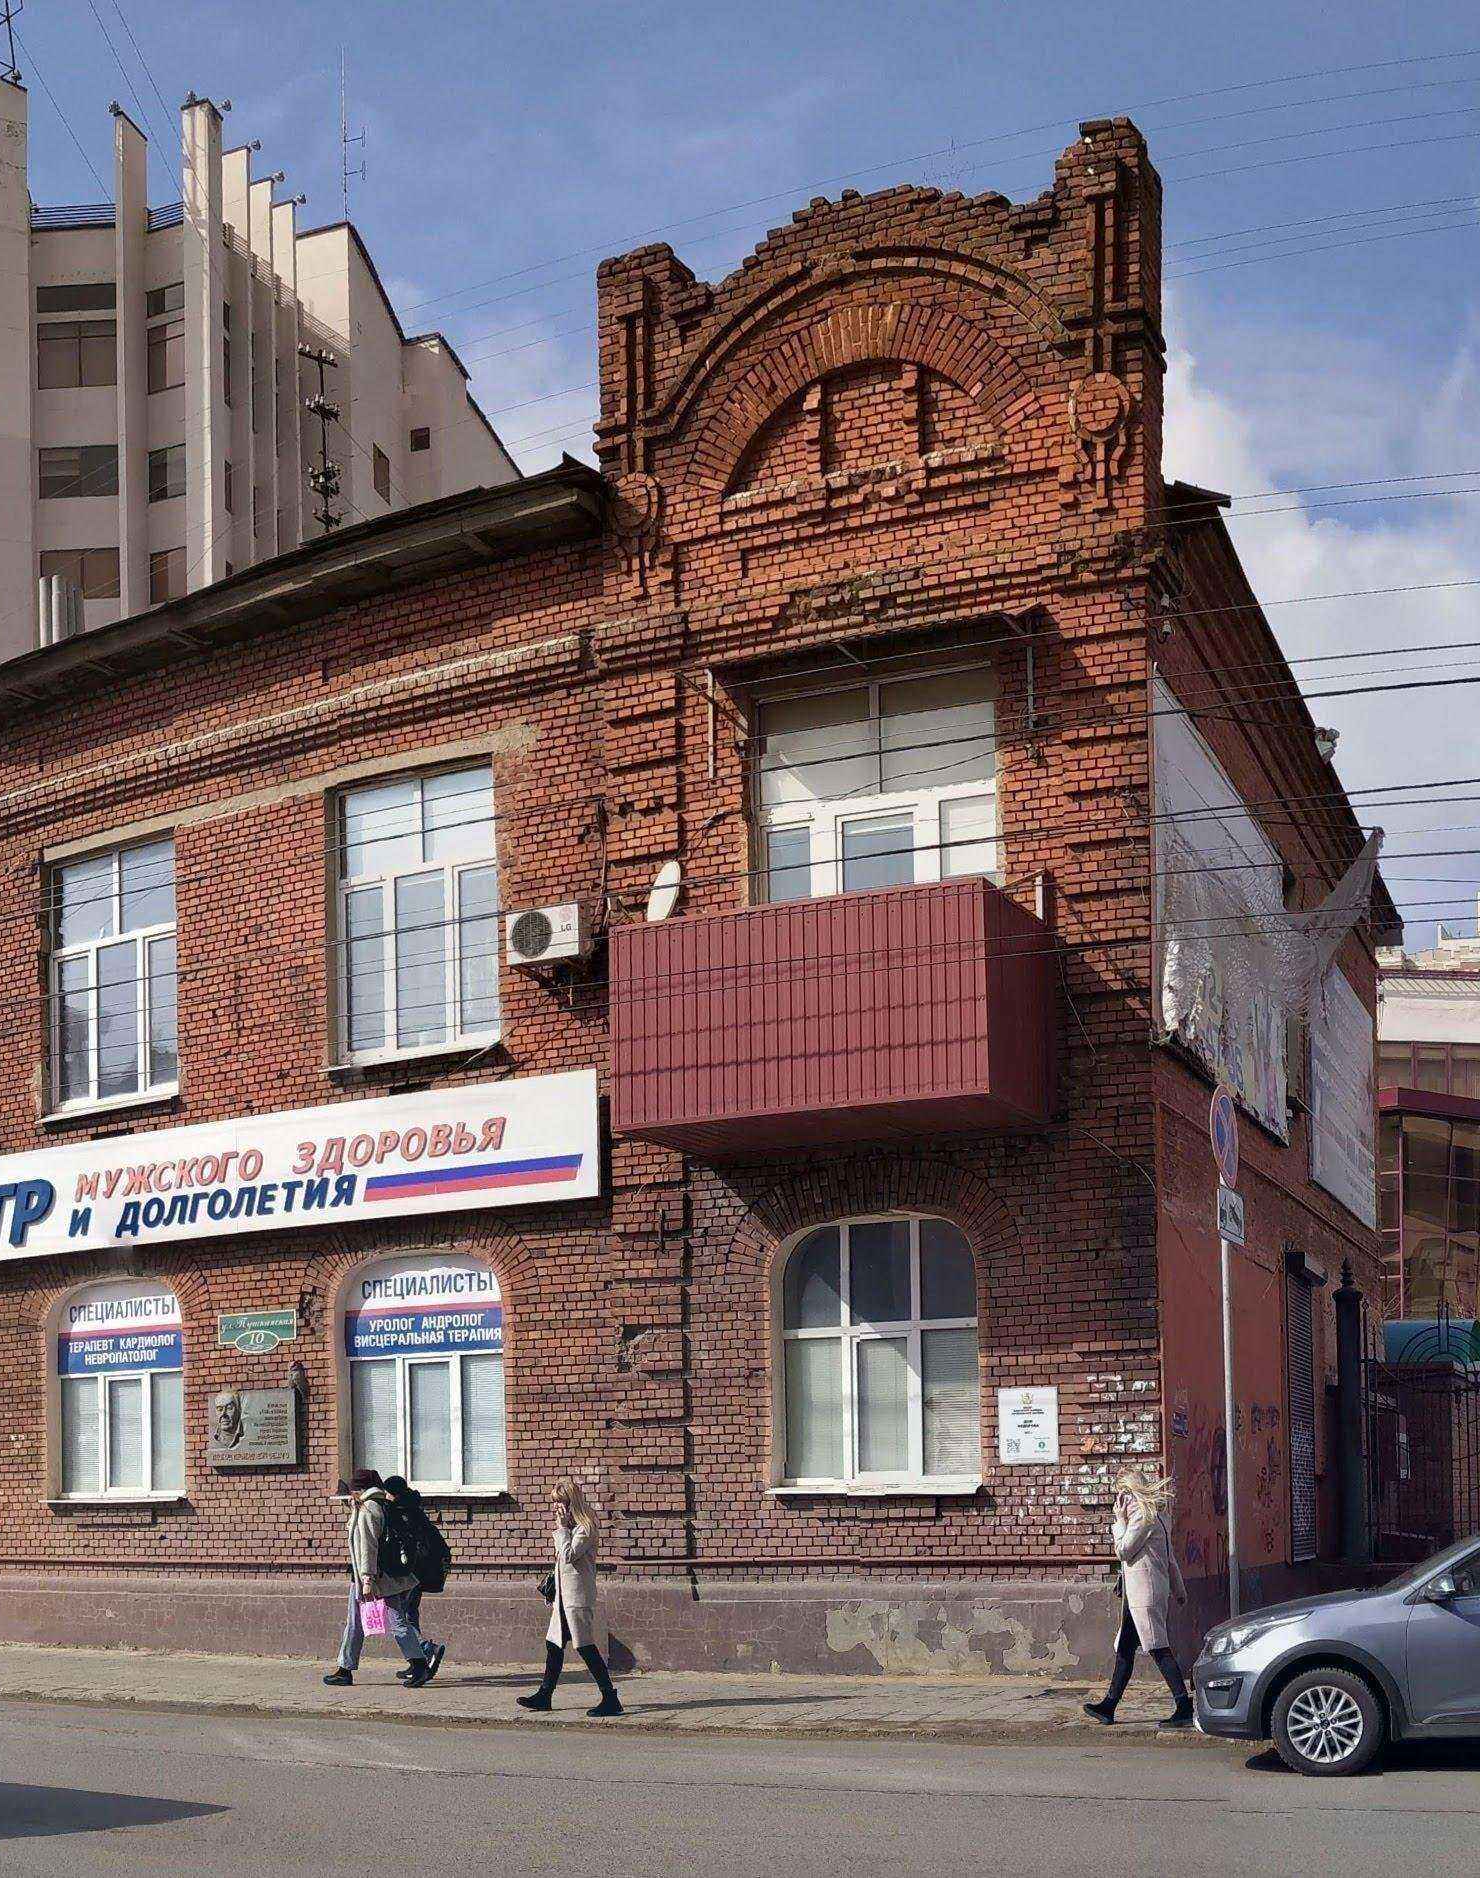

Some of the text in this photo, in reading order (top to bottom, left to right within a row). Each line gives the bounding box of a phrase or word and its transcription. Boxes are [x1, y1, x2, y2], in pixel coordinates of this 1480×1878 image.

[560, 923, 572, 932] LG
[75, 1116, 508, 1202] МУЖСКОГО ЗДОРОВЬЯ
[69, 1174, 358, 1239] И ДОЛГОЛЕТИЯ
[362, 1271, 493, 1300] СПЕЦИАЛИСТЫ
[70, 1296, 175, 1323] СПЕЦИАЛИСТЫ
[369, 1313, 486, 1332] УРОЛОГ АНДРОЛОГ
[69, 1334, 178, 1354] ТЕРАПЕВТ КАРДИОЛОГ
[249, 1333, 265, 1345] 10
[354, 1327, 502, 1348] ВИСЦЕРАЛЬНАЯ ТЕРАПИЯ
[85, 1349, 160, 1366] НЕВРОПАТОЛОГ
